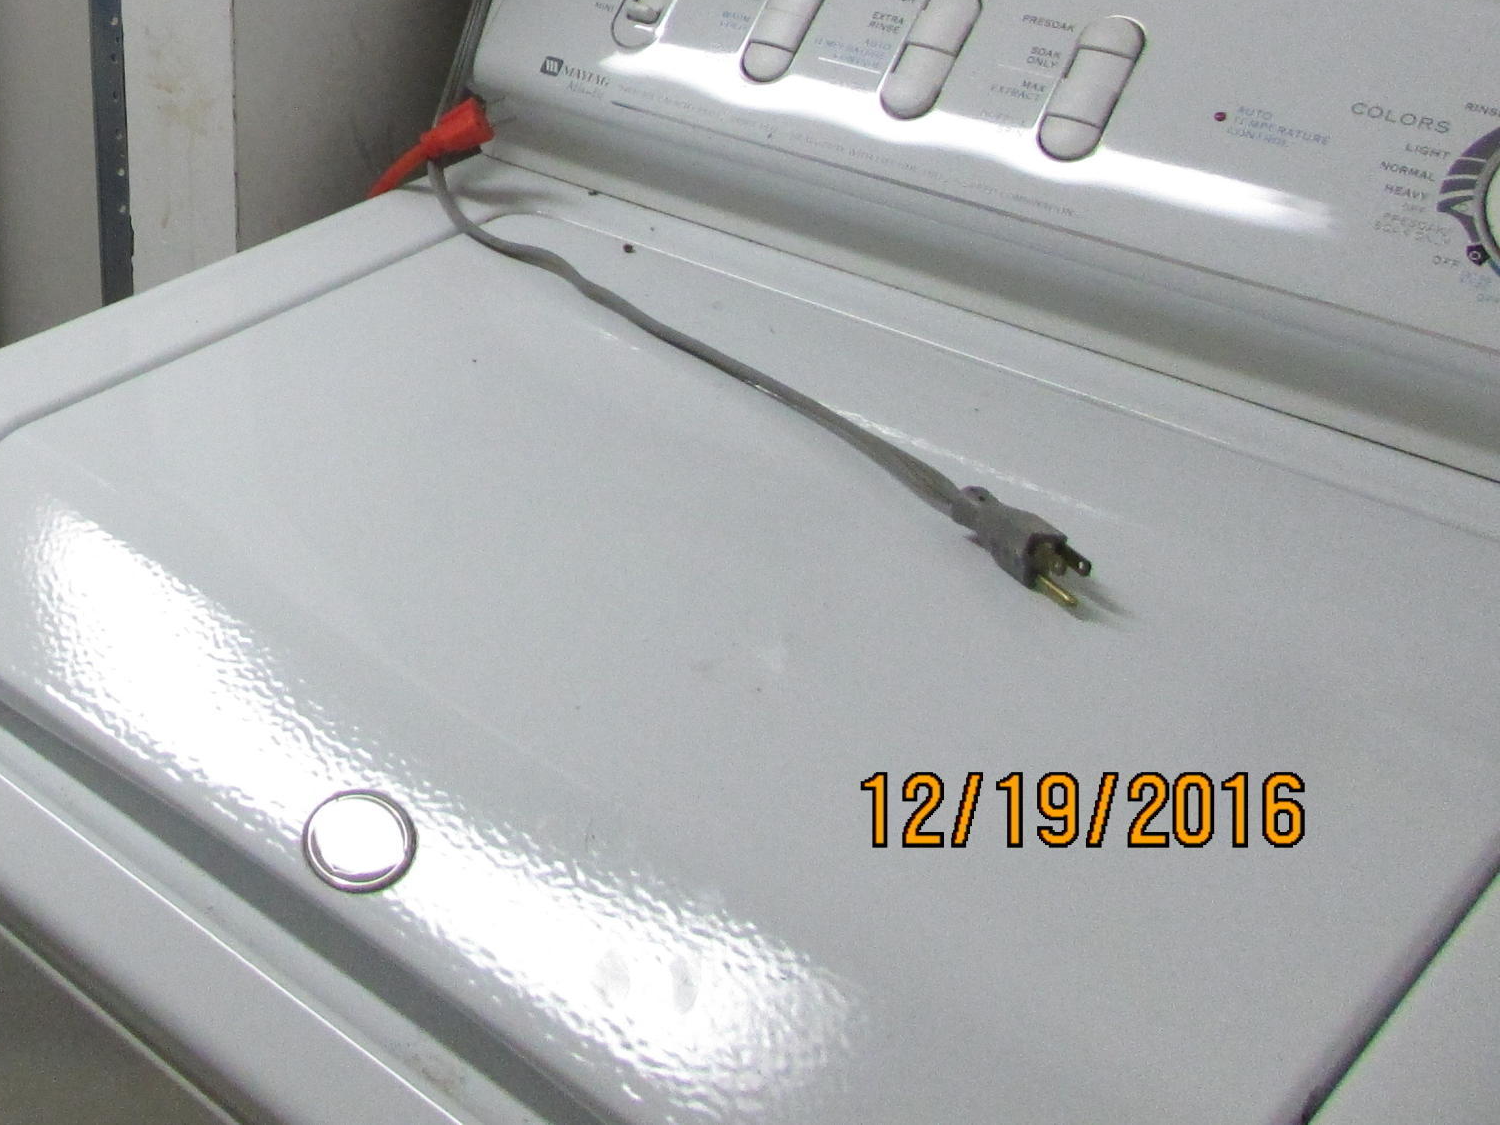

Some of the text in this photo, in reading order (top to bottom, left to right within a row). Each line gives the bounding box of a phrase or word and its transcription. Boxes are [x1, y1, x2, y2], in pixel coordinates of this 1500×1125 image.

[871, 11, 904, 25] EXTRA
[1021, 14, 1075, 33] PRESOAK
[867, 21, 901, 34] RINSE
[1030, 46, 1060, 58] SOAK
[1026, 55, 1060, 68] ONLY
[1350, 101, 1452, 134] COLORS
[1465, 101, 1500, 117] RINS
[1405, 142, 1451, 160] LIGHT
[1380, 160, 1436, 182] NORMAL
[1384, 183, 1428, 201] HEAVY
